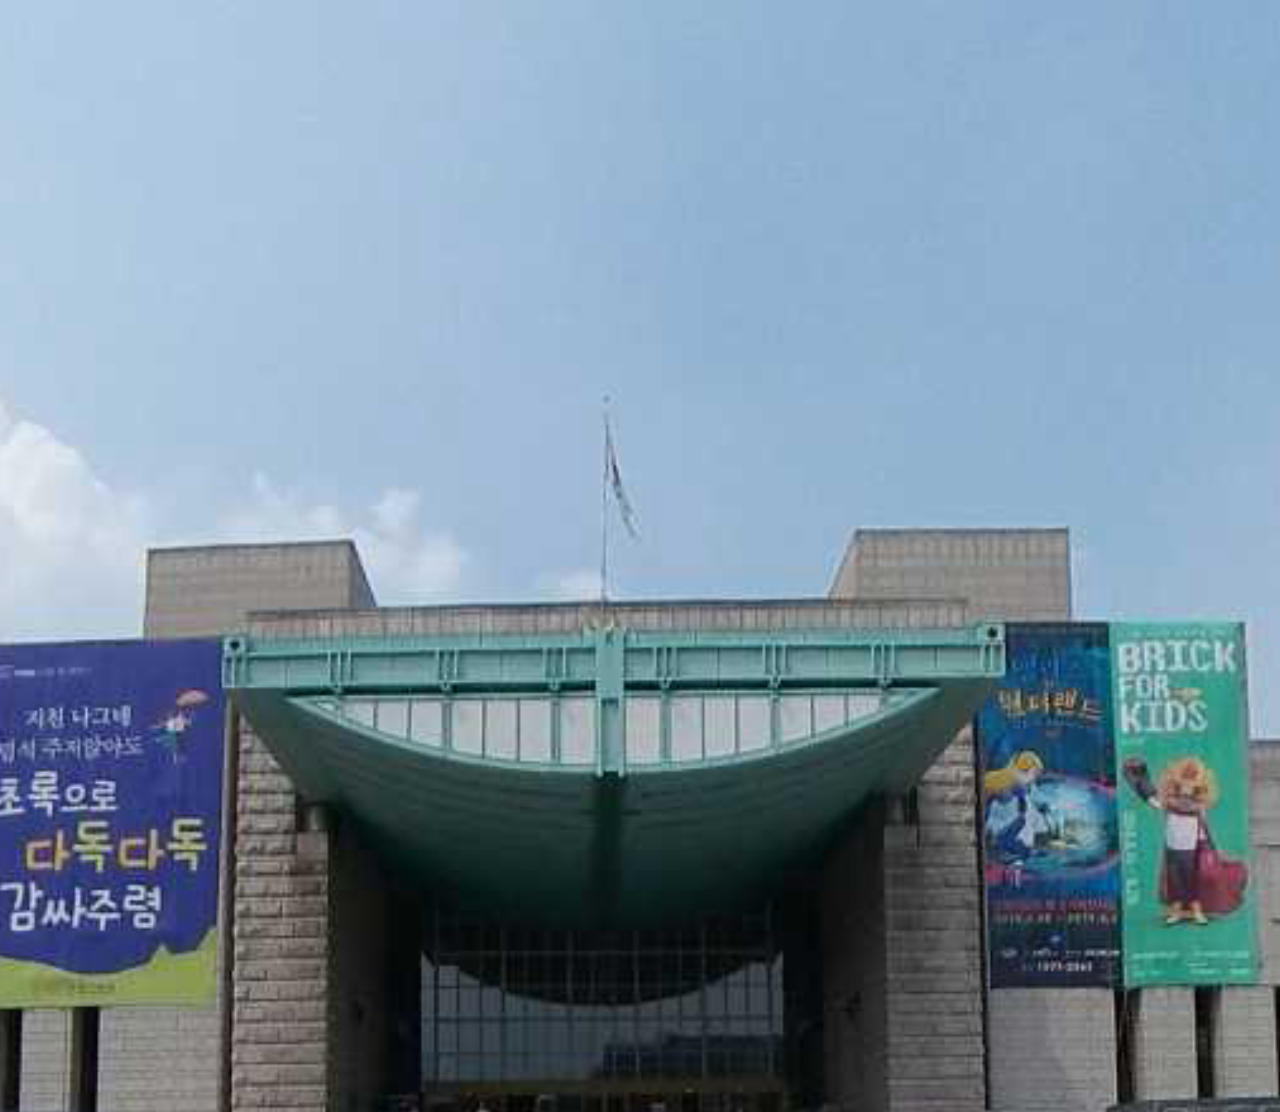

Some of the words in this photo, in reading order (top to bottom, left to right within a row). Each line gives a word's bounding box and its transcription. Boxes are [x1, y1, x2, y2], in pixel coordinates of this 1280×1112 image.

[1118, 640, 1236, 673] BRICK
[1119, 674, 1169, 700] FOR
[1120, 701, 1208, 734] KIDS
[25, 818, 208, 873] 다독다독
